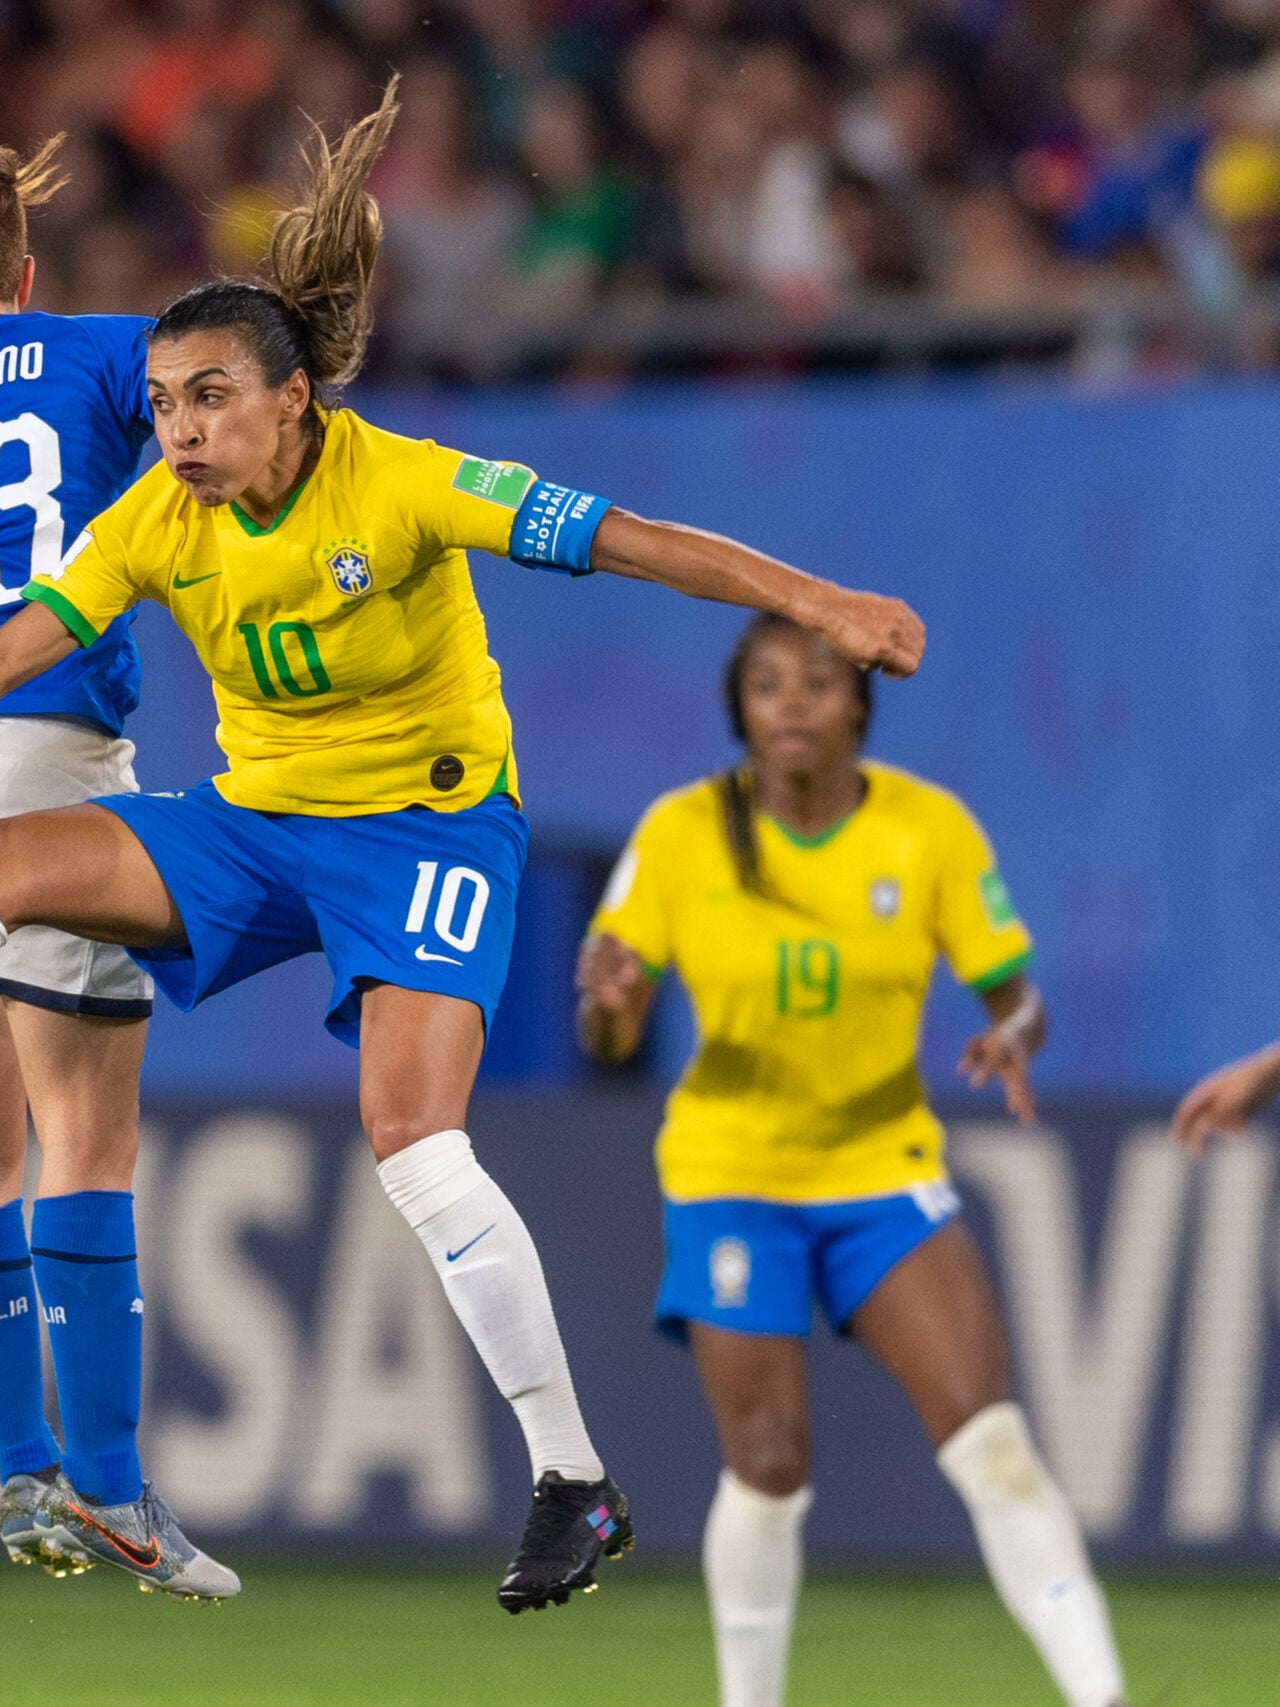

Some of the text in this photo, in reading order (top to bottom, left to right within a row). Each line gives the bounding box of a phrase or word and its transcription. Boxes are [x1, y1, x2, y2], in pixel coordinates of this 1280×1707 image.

[523, 482, 557, 558] LIVING
[570, 494, 595, 520] FIFA
[238, 621, 332, 699] 10
[405, 861, 490, 953] 10
[776, 938, 839, 1017] 19
[42, 1305, 67, 1324] LIA
[946, 1118, 1280, 1538] VI
